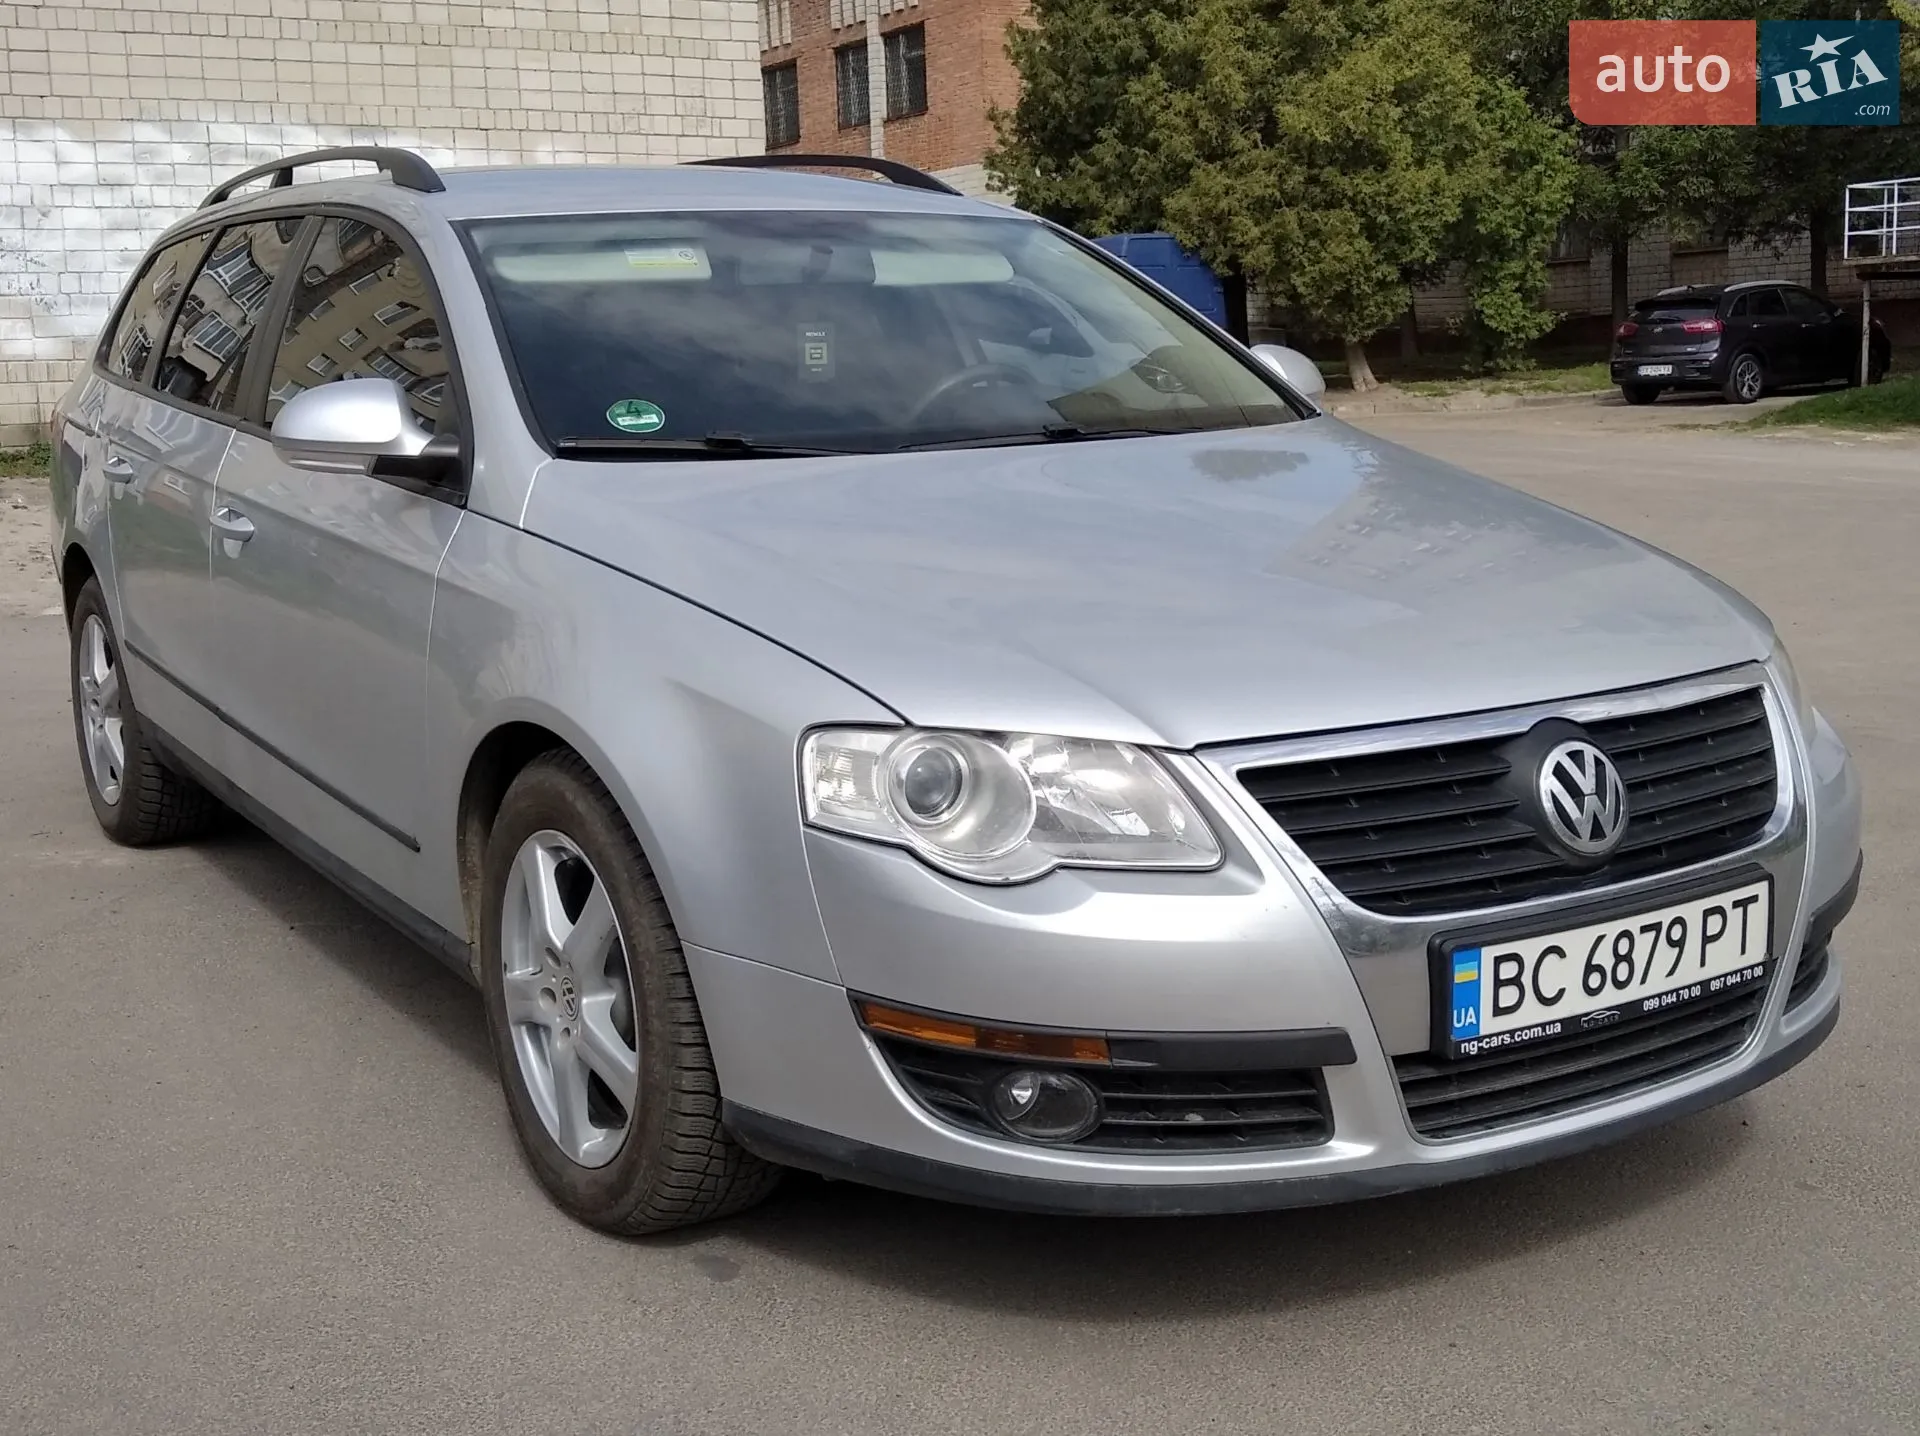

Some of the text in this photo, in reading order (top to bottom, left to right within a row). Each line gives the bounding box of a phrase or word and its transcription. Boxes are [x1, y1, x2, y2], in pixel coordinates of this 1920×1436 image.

[1492, 894, 1760, 1017] BC 6879 PT
[1710, 965, 1763, 991] 097 044 70 00
[1643, 985, 1701, 1011] 099 044 70 00
[1453, 1006, 1477, 1028] UA
[1460, 1022, 1562, 1055] ng-cars.com.ua
